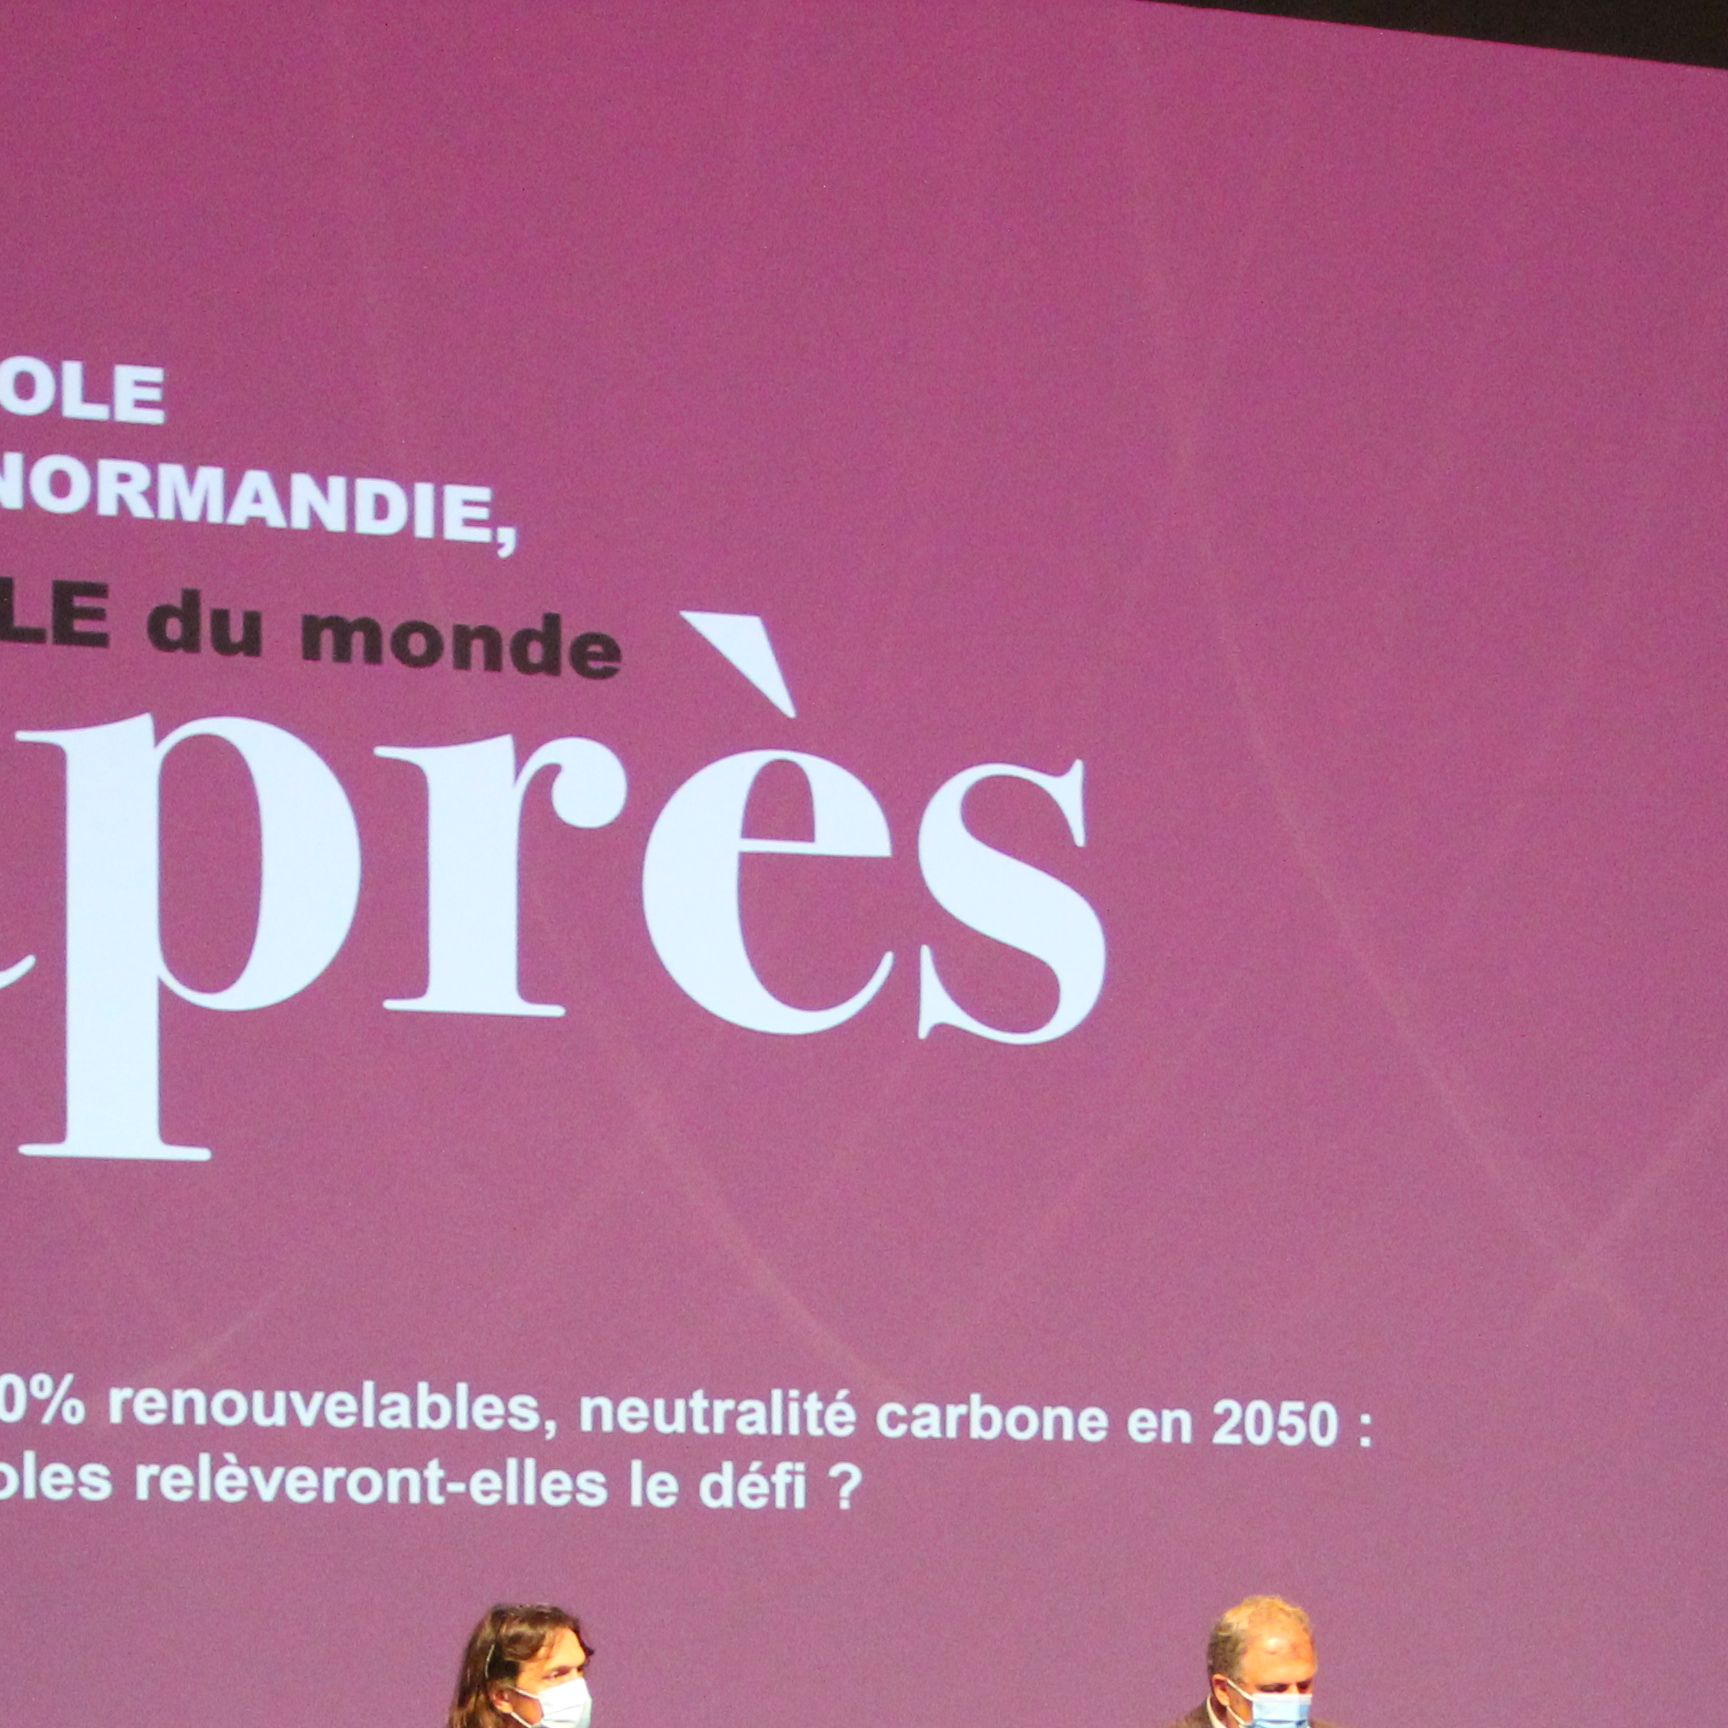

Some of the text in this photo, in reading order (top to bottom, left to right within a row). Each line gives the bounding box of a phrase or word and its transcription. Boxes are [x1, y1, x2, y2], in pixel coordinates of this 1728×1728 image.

[146, 588, 262, 657] du
[301, 612, 621, 680] monde
[108, 1379, 558, 1441] renouvelables,
[579, 1387, 858, 1438] neutralité
[875, 1392, 1110, 1443] carbone
[1127, 1407, 1193, 1445] en
[1211, 1398, 1339, 1448] 2050
[135, 1451, 609, 1508] relèveront-elles
[630, 1458, 680, 1509] le
[698, 1460, 807, 1510] défi
